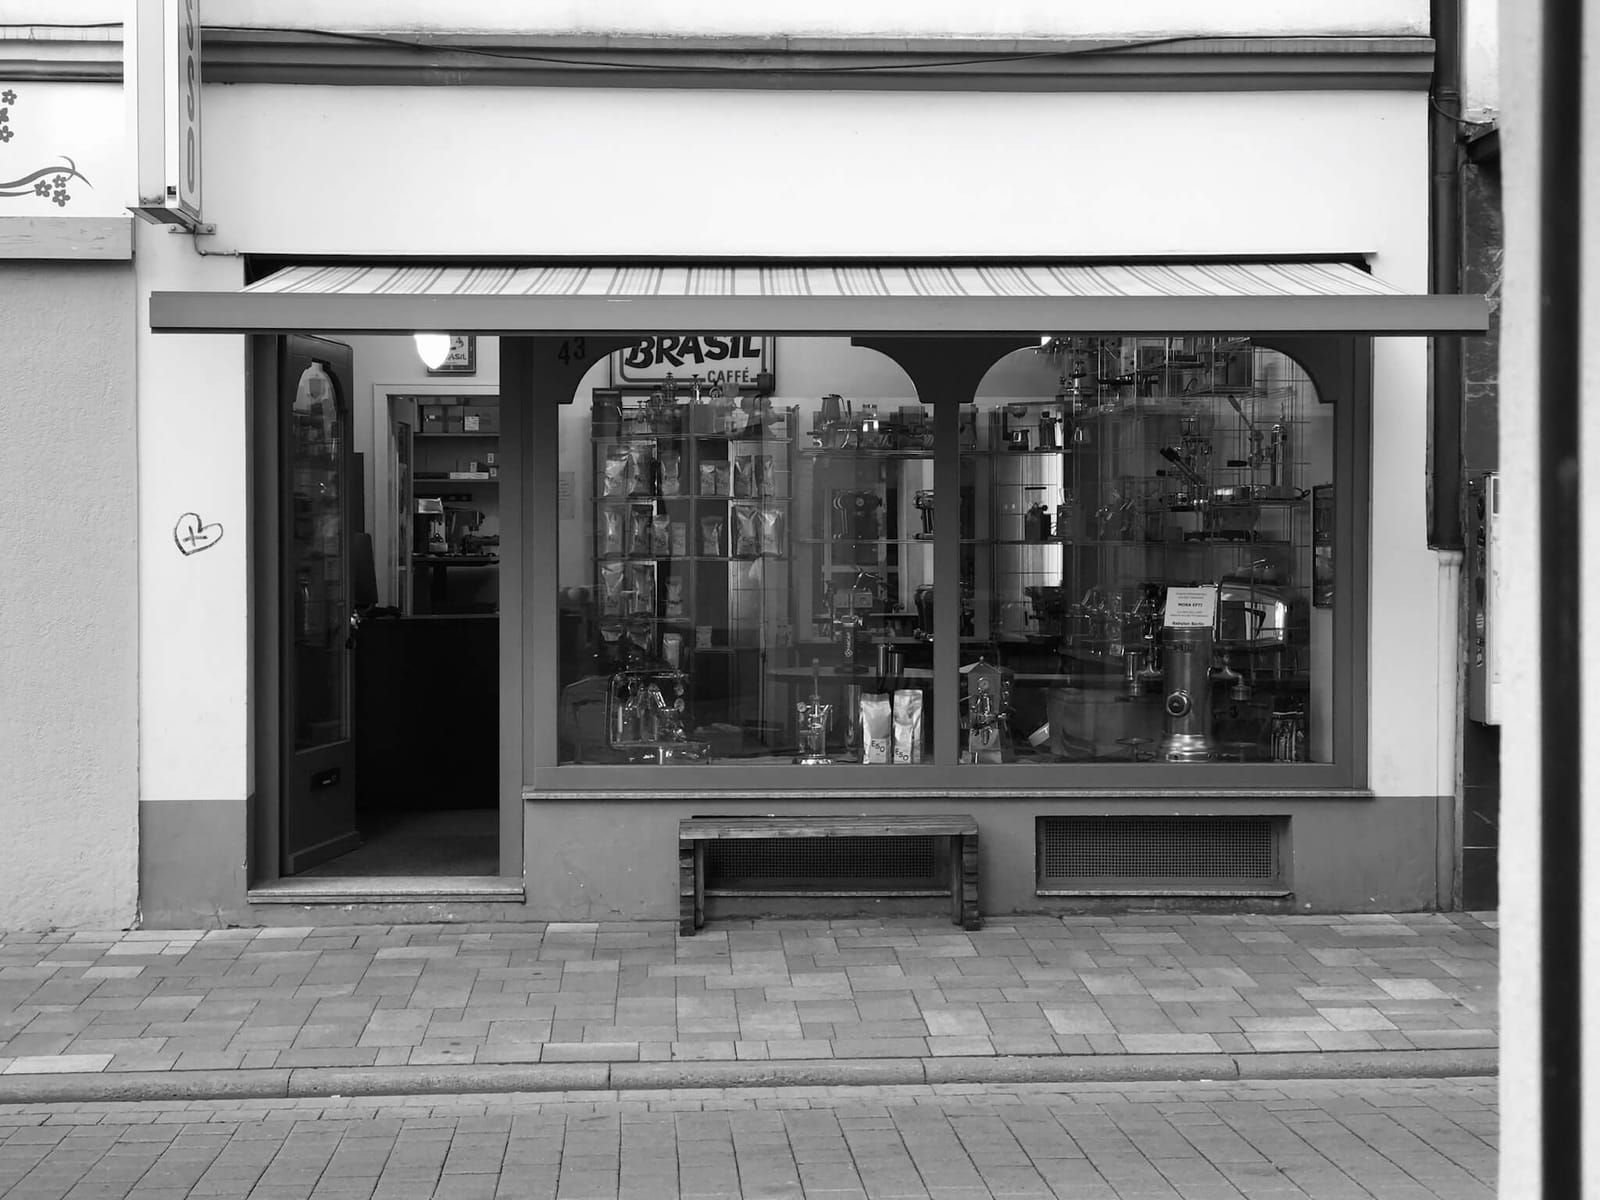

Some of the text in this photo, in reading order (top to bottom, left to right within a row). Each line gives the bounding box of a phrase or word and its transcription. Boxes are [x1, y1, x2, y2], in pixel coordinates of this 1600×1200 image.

[557, 336, 585, 366] 43
[624, 336, 761, 369] BRASIL
[707, 366, 750, 383] CAFFÉ
